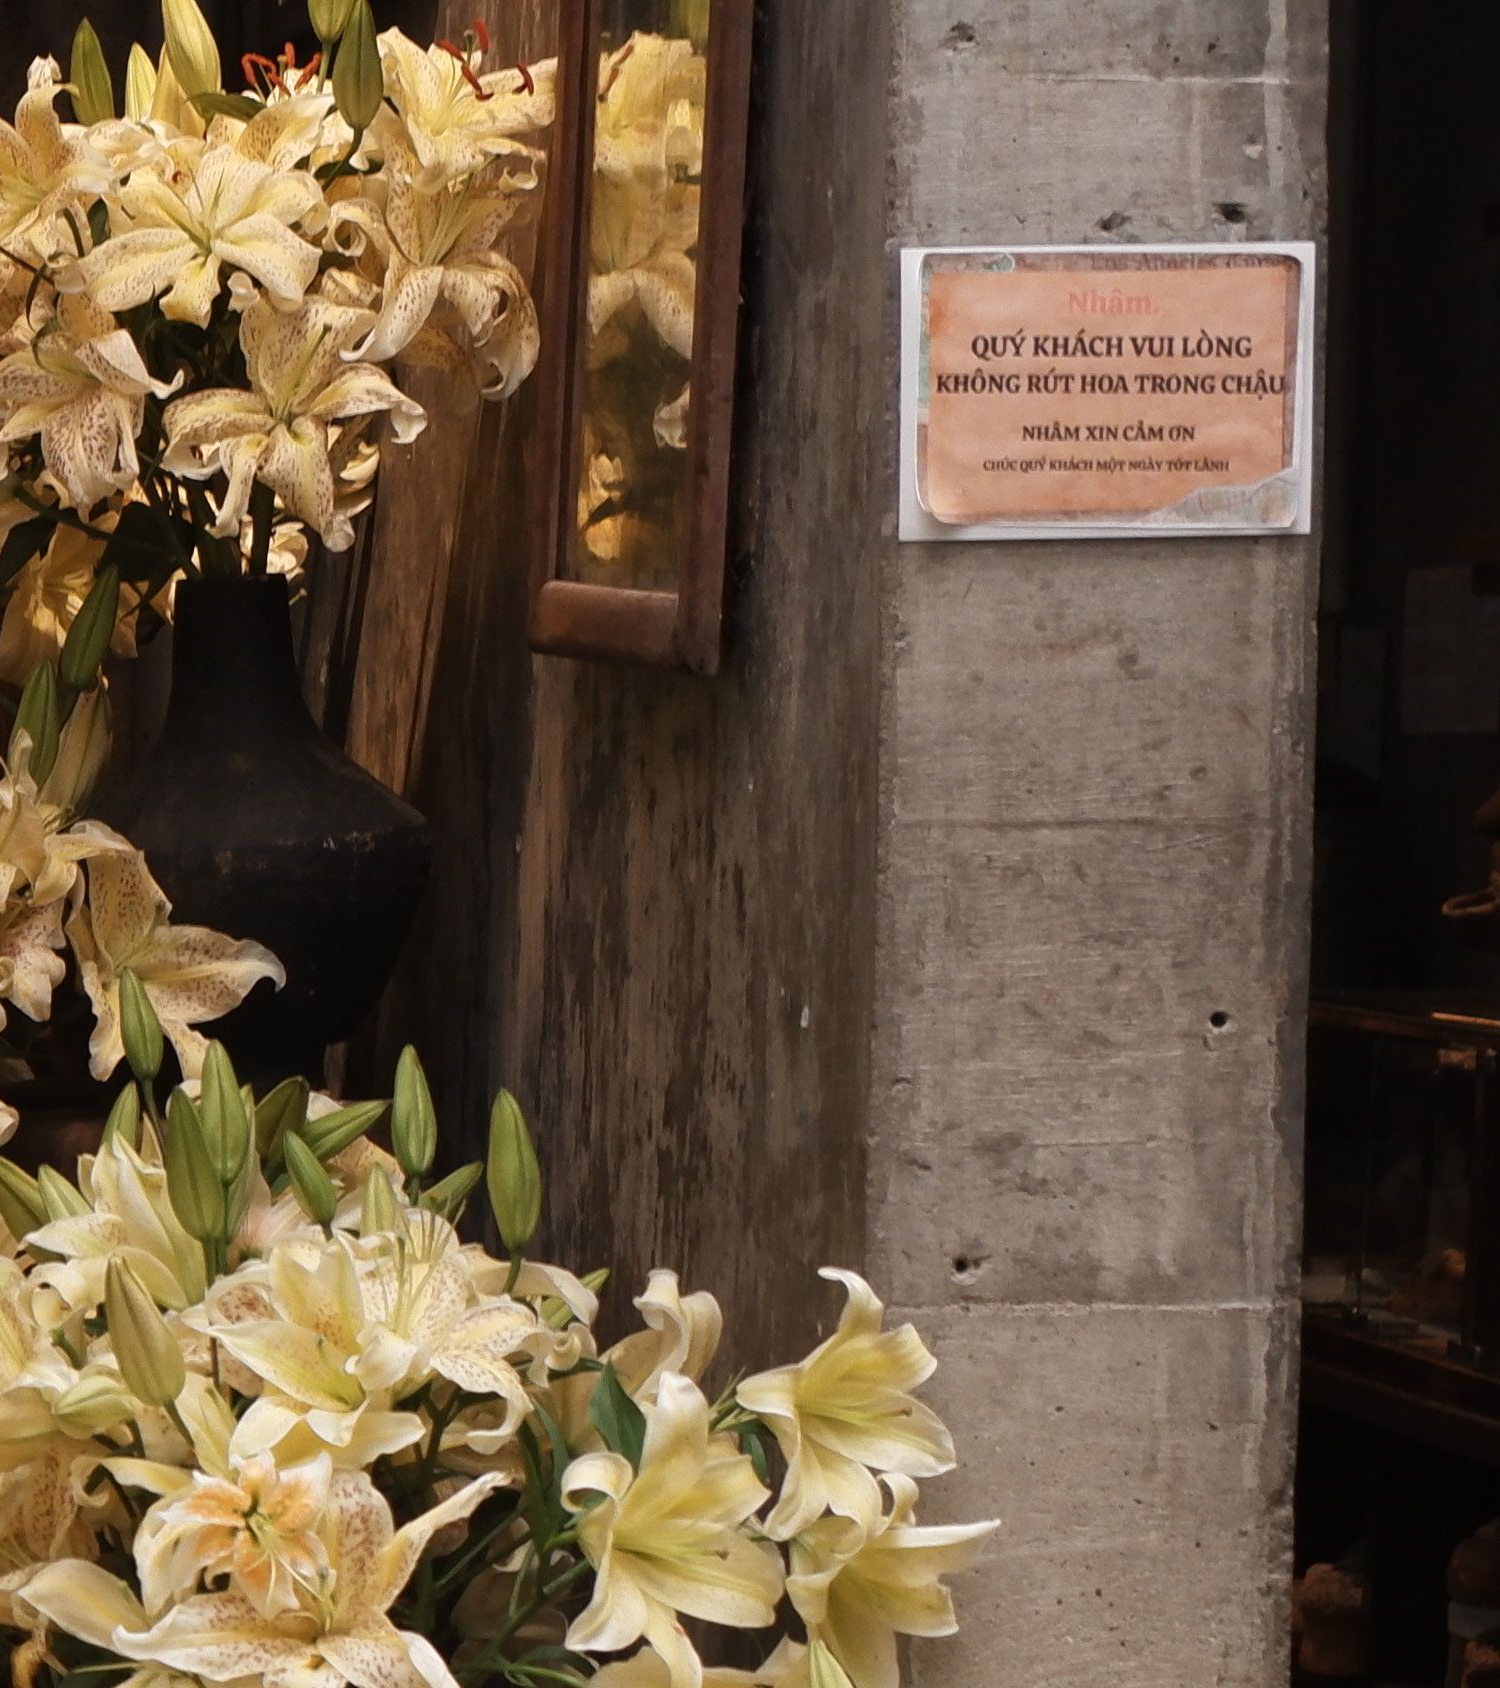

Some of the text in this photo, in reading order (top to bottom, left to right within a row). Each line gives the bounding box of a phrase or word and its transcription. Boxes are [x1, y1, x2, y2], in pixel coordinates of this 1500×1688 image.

[971, 327, 1253, 361] QUÝ KHÁCH VUI LÒNG
[936, 367, 1285, 400] KHÔNG RÚT HOA TRONG CHẬU
[1085, 425, 1118, 441] XIN
[1122, 419, 1164, 441] CẢM
[1168, 424, 1196, 441] ƠN
[1049, 457, 1093, 472] KHÁCH
